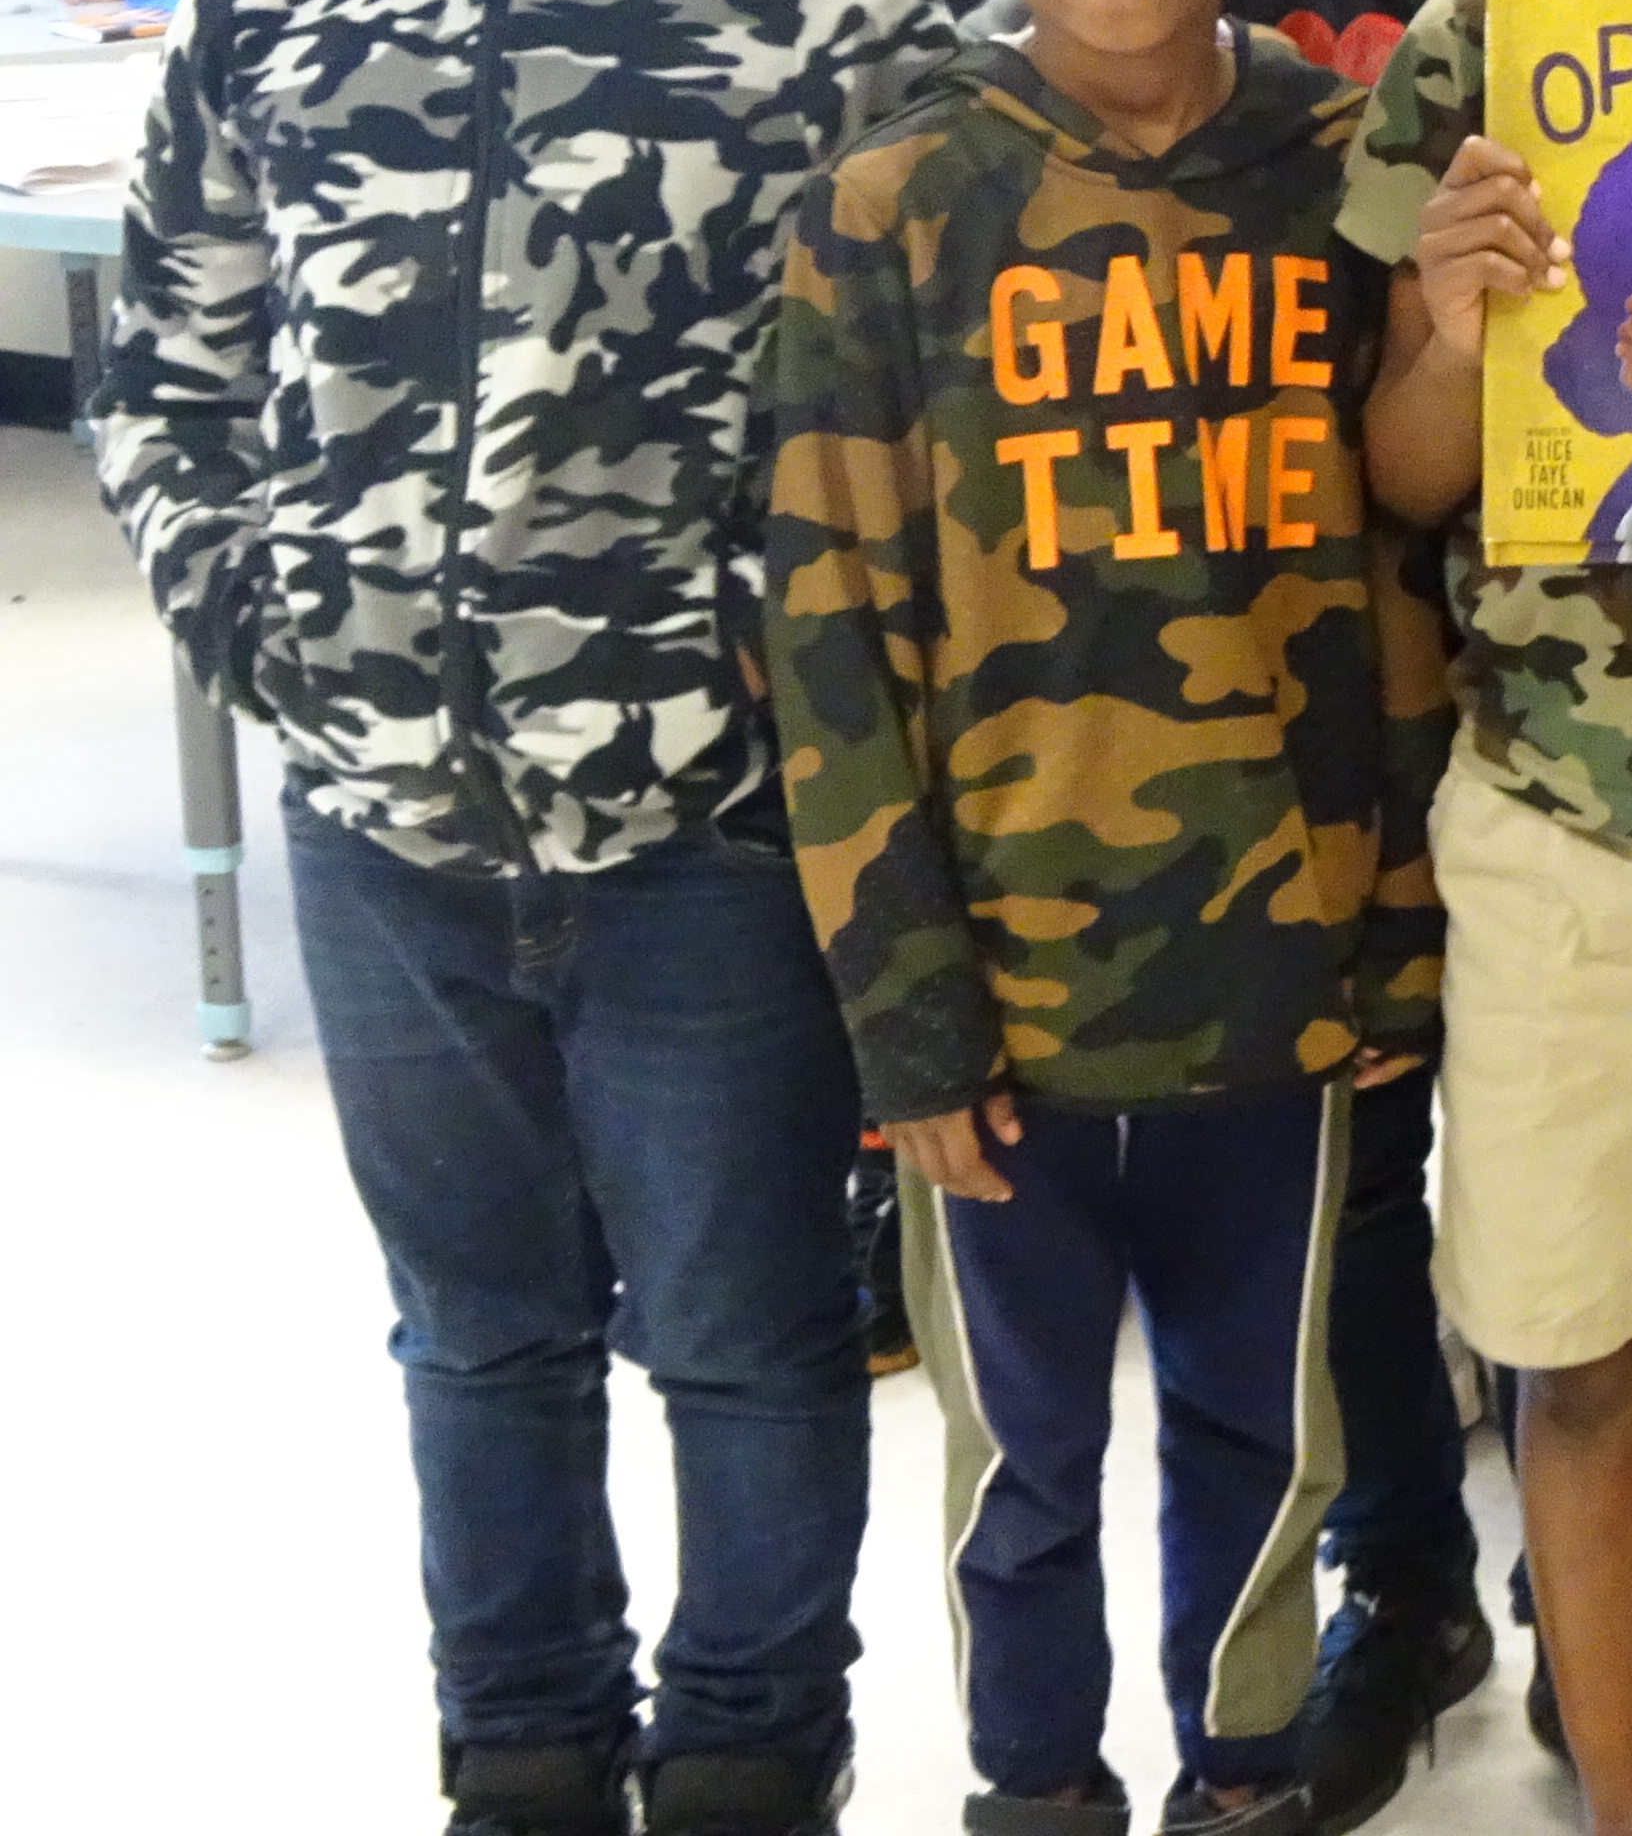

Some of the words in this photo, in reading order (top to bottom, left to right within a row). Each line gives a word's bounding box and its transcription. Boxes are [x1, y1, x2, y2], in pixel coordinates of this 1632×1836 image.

[989, 252, 1334, 407] GAME
[1525, 439, 1572, 461] ALICE
[1529, 463, 1568, 486] FAYE
[994, 417, 1328, 571] TIME
[1512, 486, 1585, 510] DUNCAN
